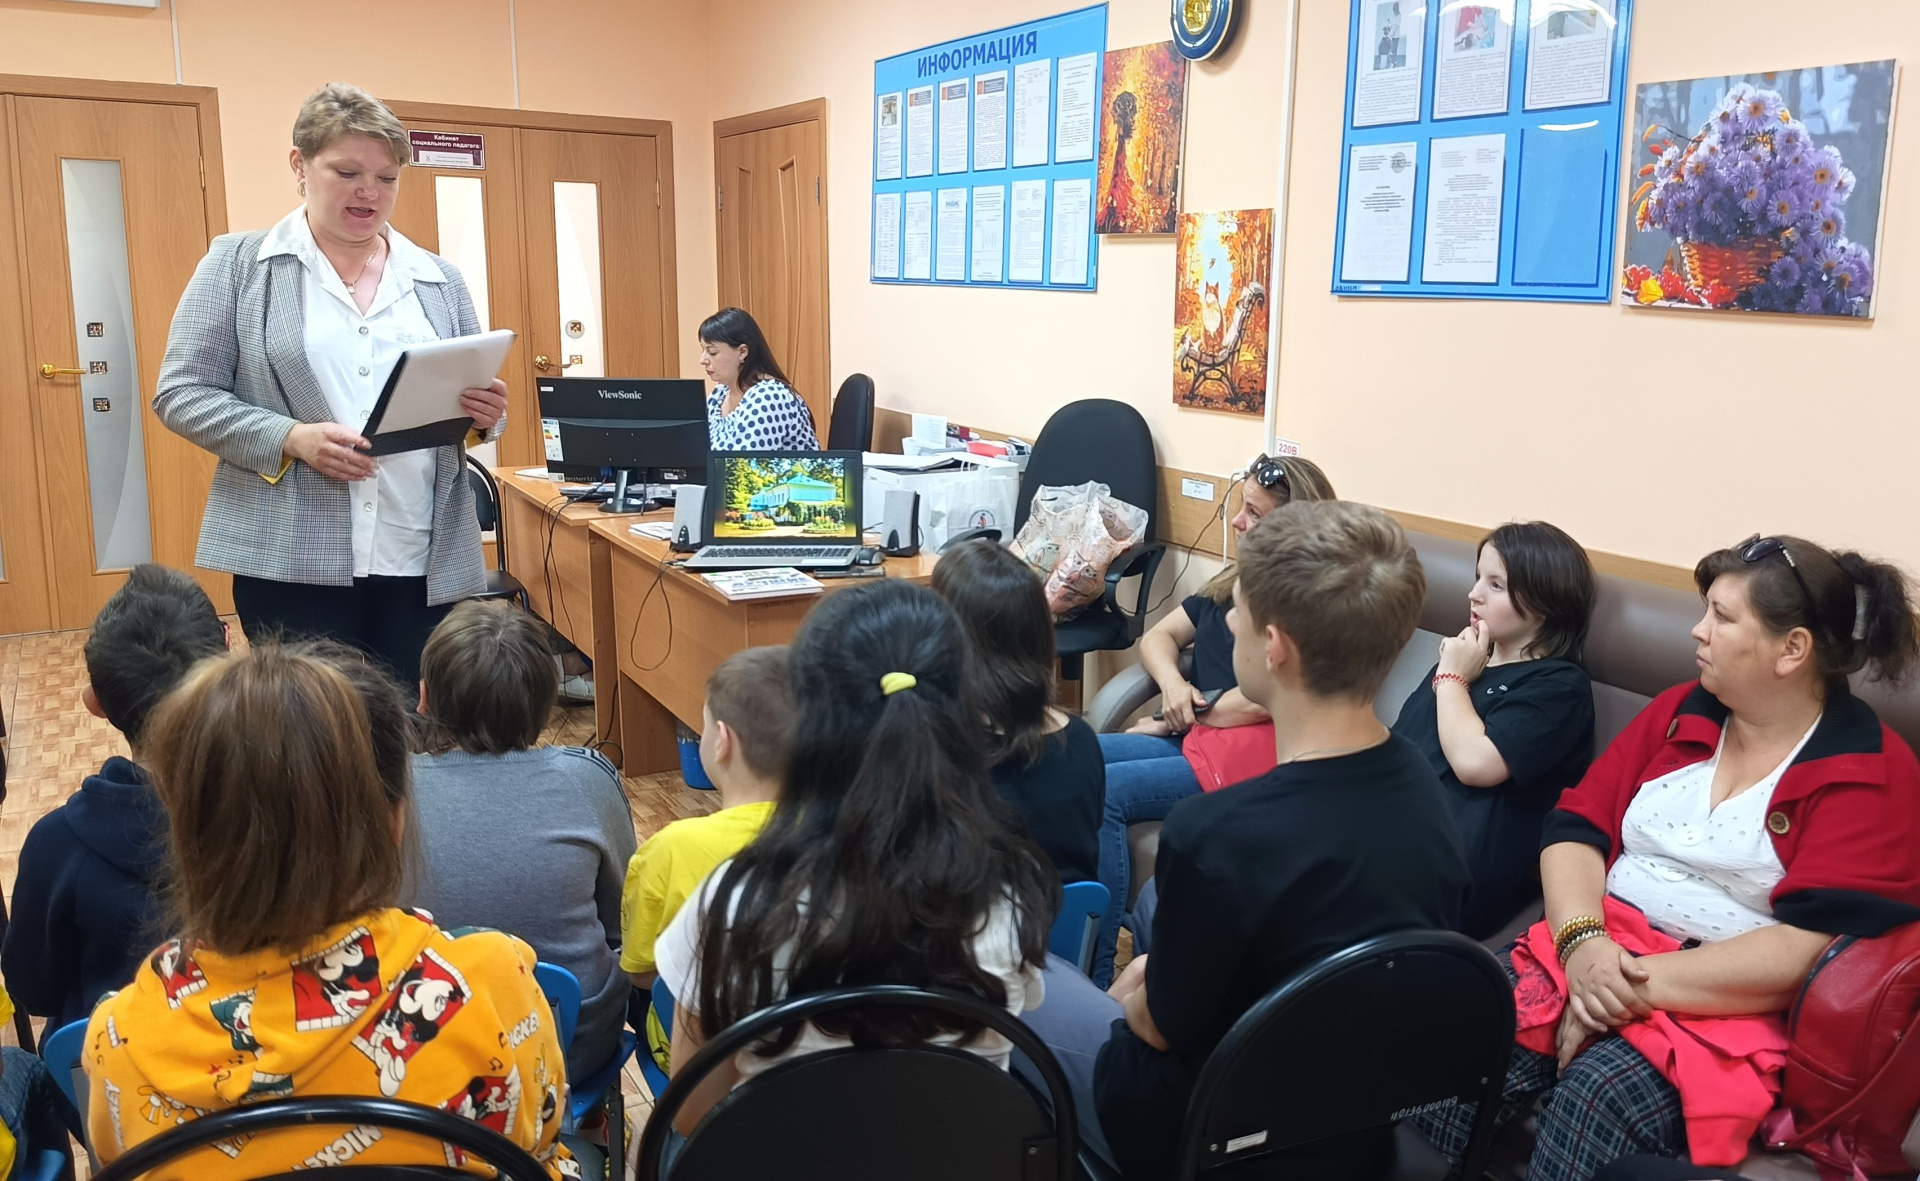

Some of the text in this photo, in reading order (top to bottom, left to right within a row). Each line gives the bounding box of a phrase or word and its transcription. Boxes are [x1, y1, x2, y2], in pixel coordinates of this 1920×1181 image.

[917, 31, 1037, 78] ИНФОРМАЦИЯ
[412, 140, 452, 148] социального
[598, 389, 643, 400] ViewSonic
[1278, 443, 1298, 456] 220В
